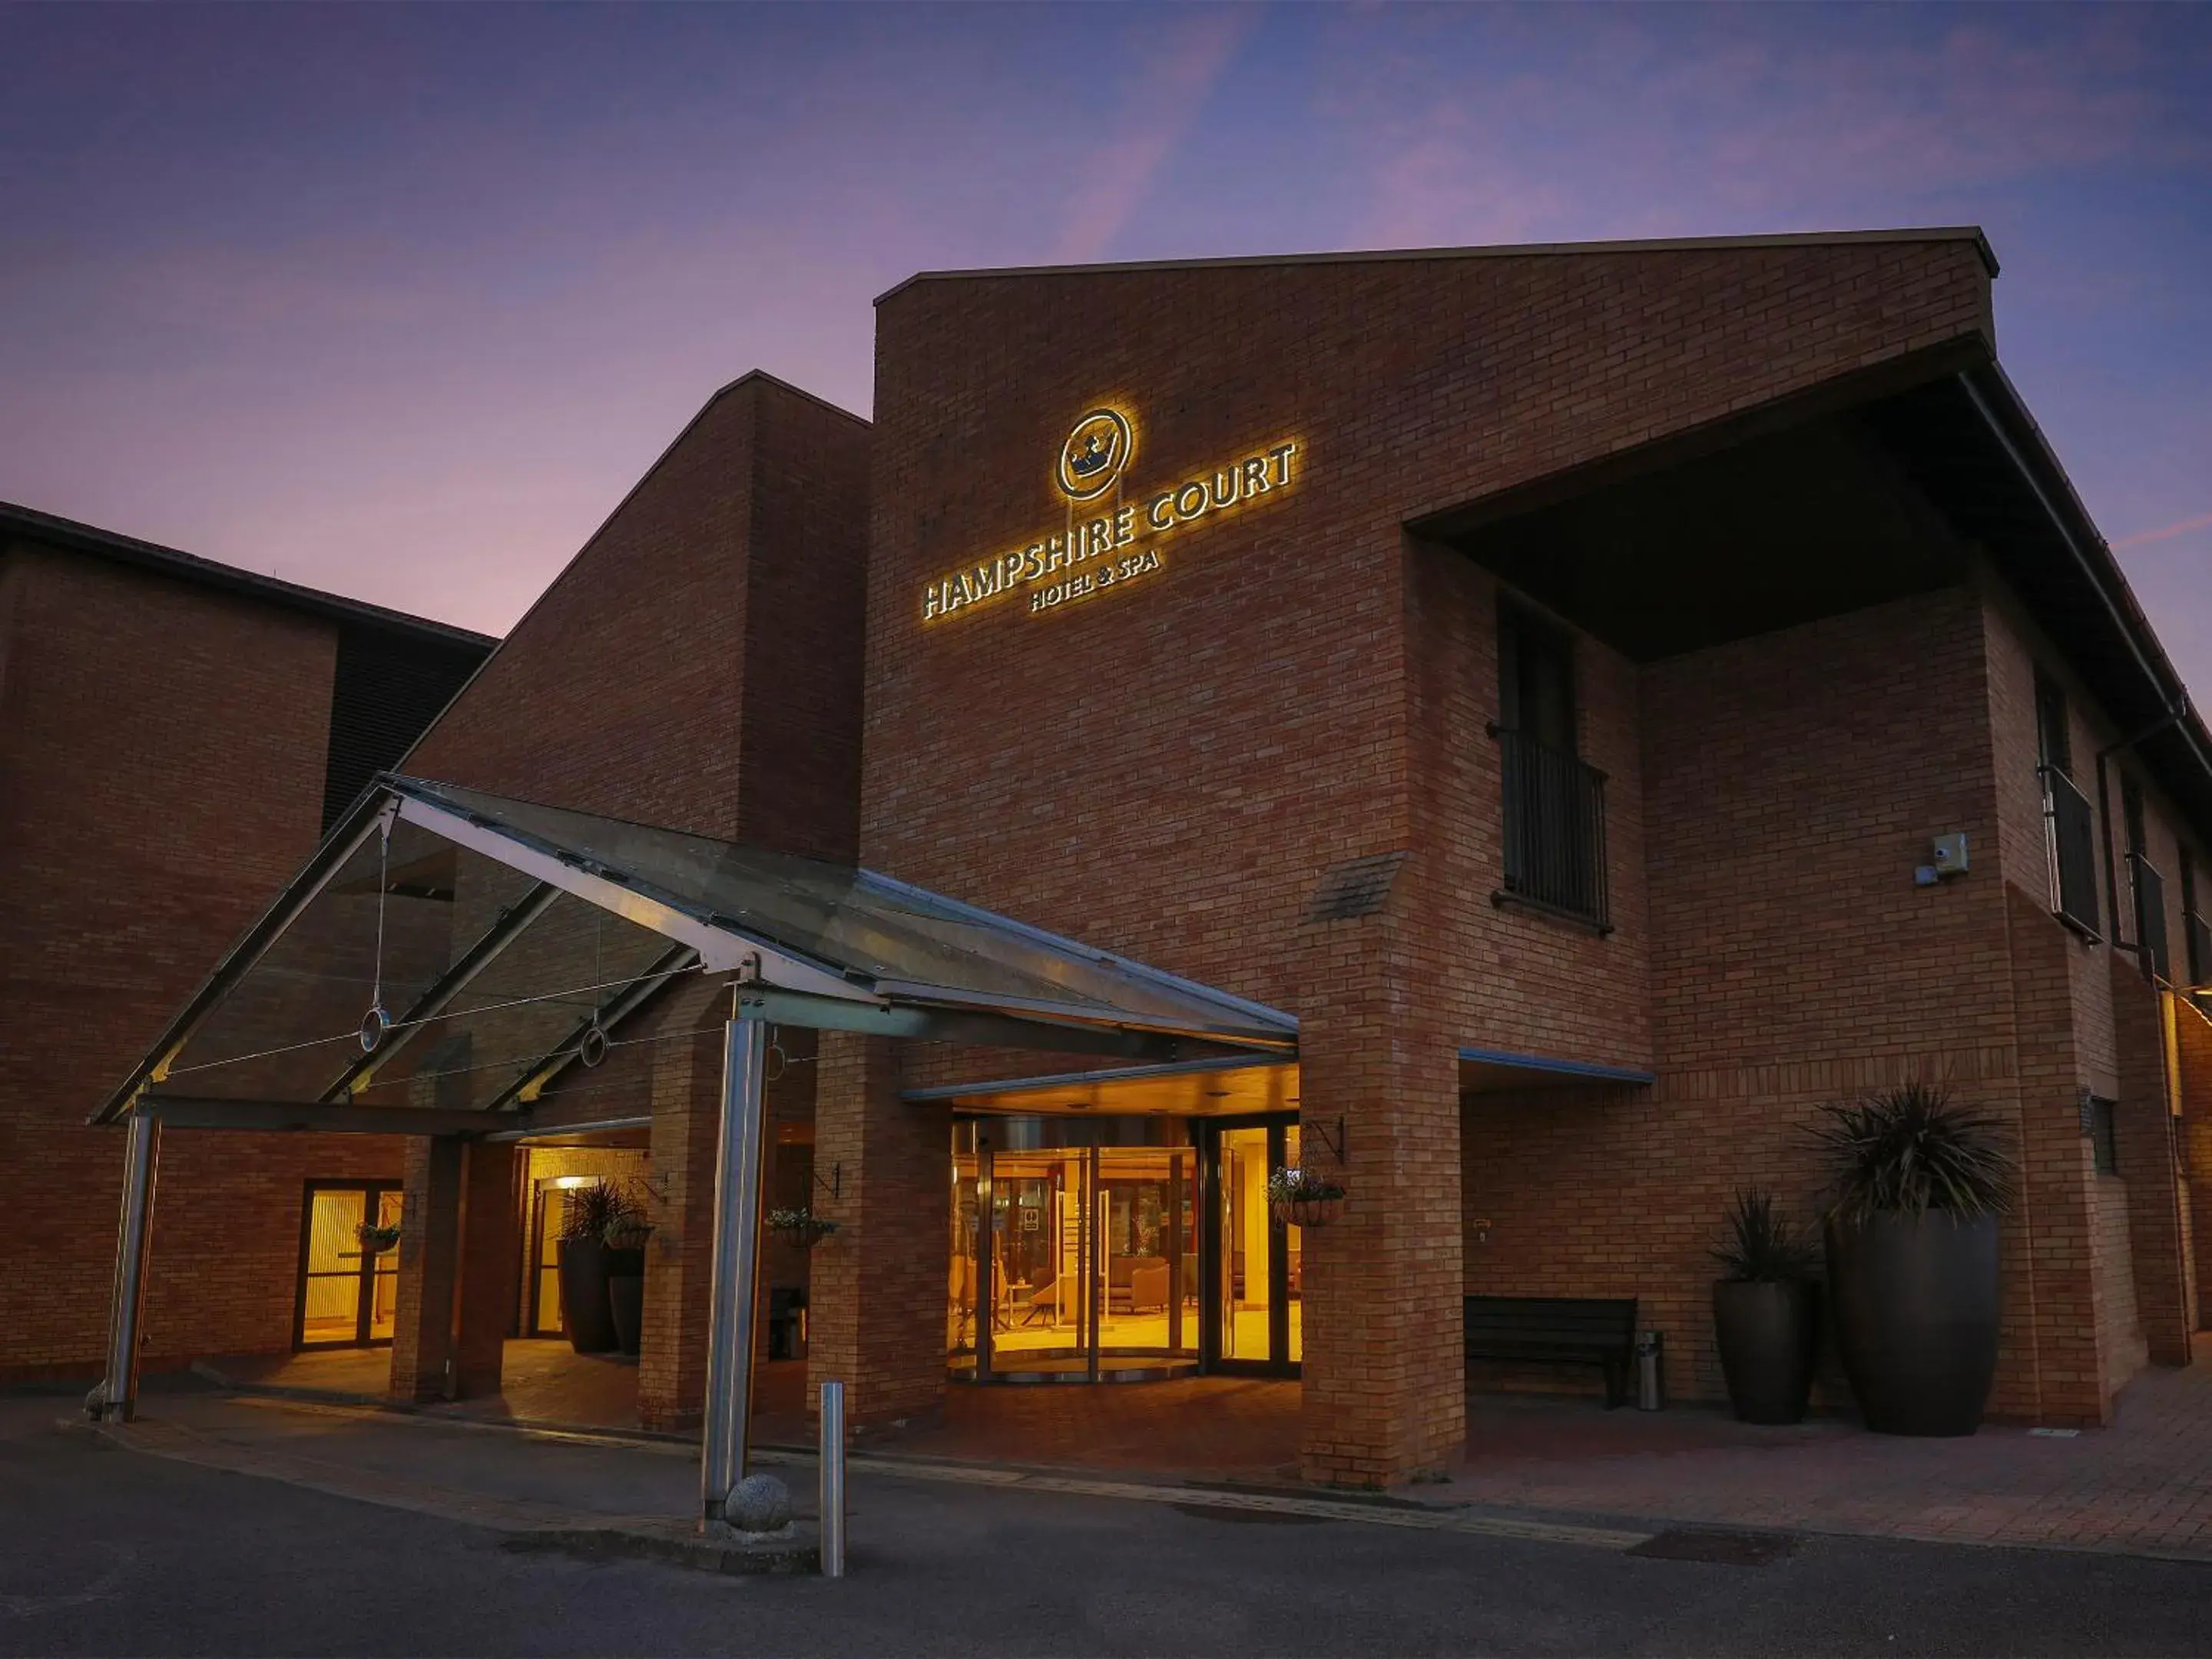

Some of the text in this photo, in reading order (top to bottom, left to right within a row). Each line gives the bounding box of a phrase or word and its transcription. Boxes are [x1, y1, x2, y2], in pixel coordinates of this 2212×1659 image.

[924, 443, 1296, 619] HAMPSHIRE COURT
[1029, 549, 1158, 611] HOTEL & SPA
